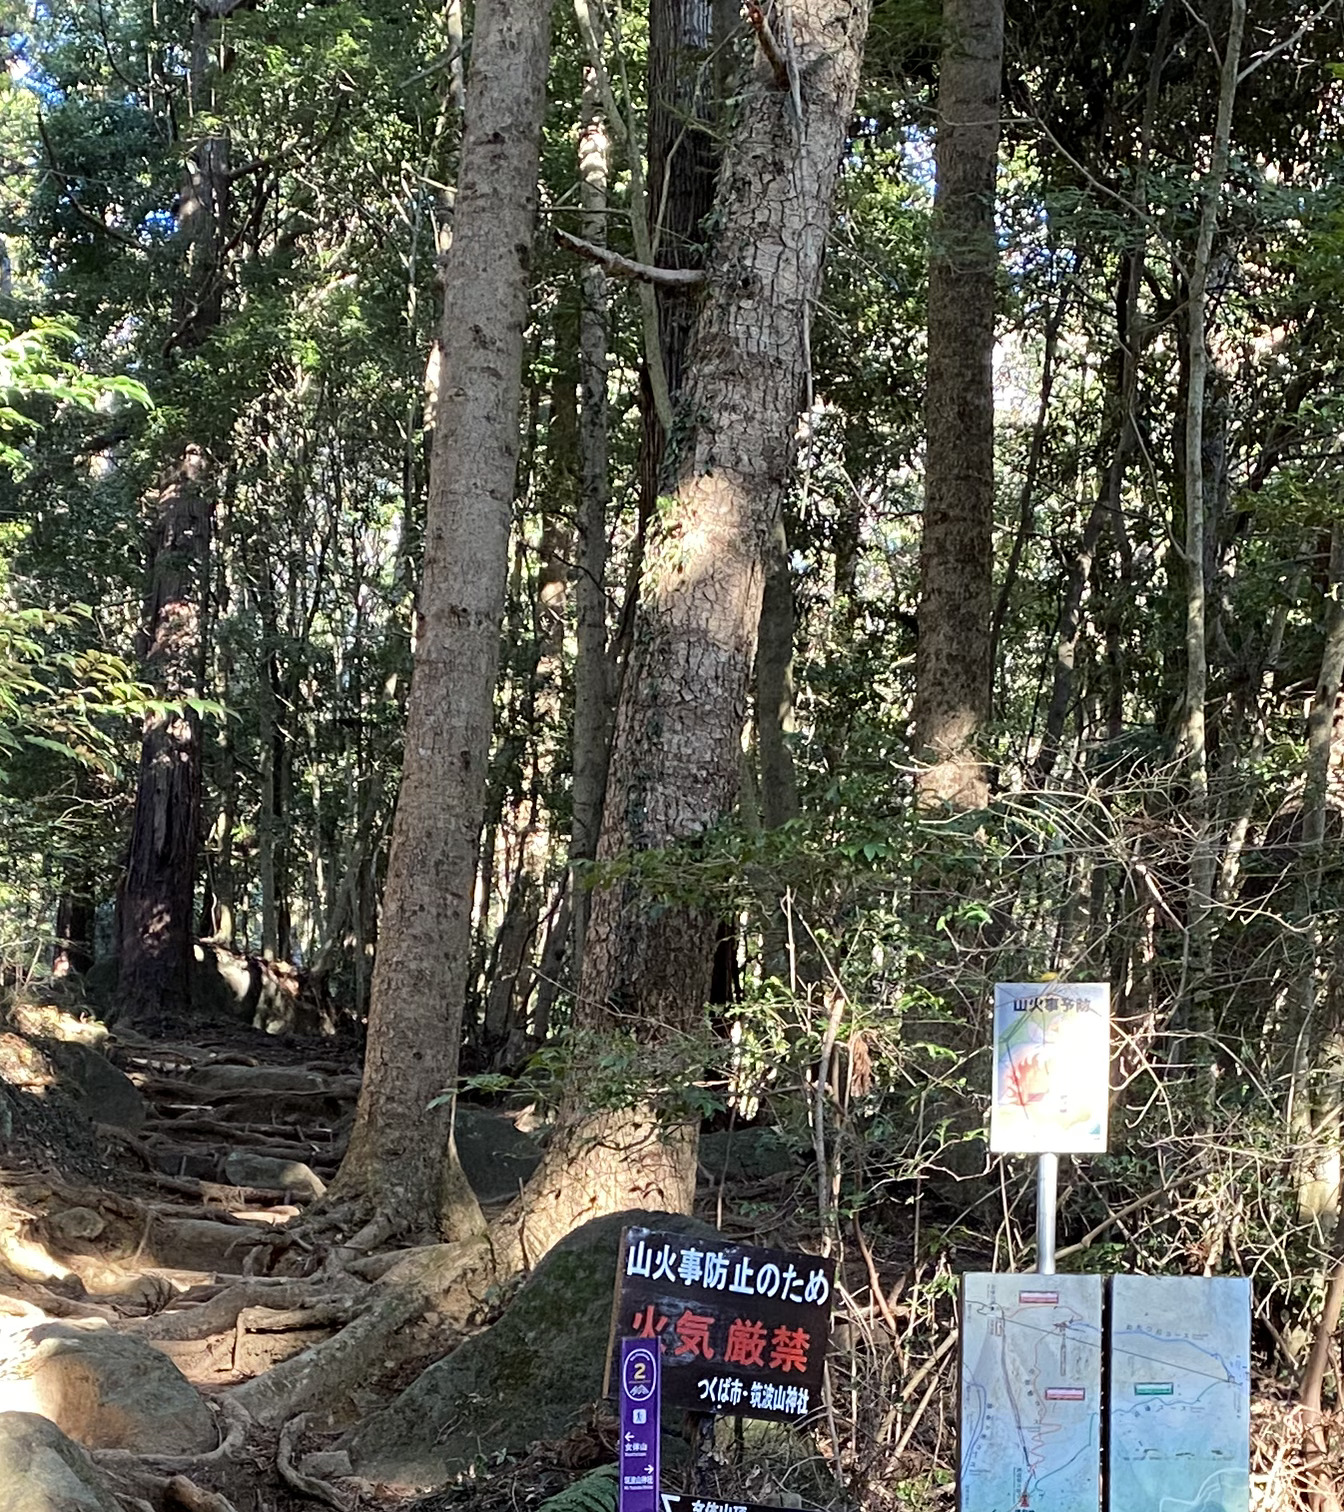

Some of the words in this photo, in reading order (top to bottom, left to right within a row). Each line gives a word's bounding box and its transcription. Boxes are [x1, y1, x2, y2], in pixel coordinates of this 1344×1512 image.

[1013, 997, 1093, 1013] 山火事予防
[626, 1240, 830, 1306] 山火事防止のため
[631, 1304, 811, 1373] 火気厳禁
[633, 1362, 647, 1380] 2
[697, 1376, 810, 1416] つくば市・筑波山神社
